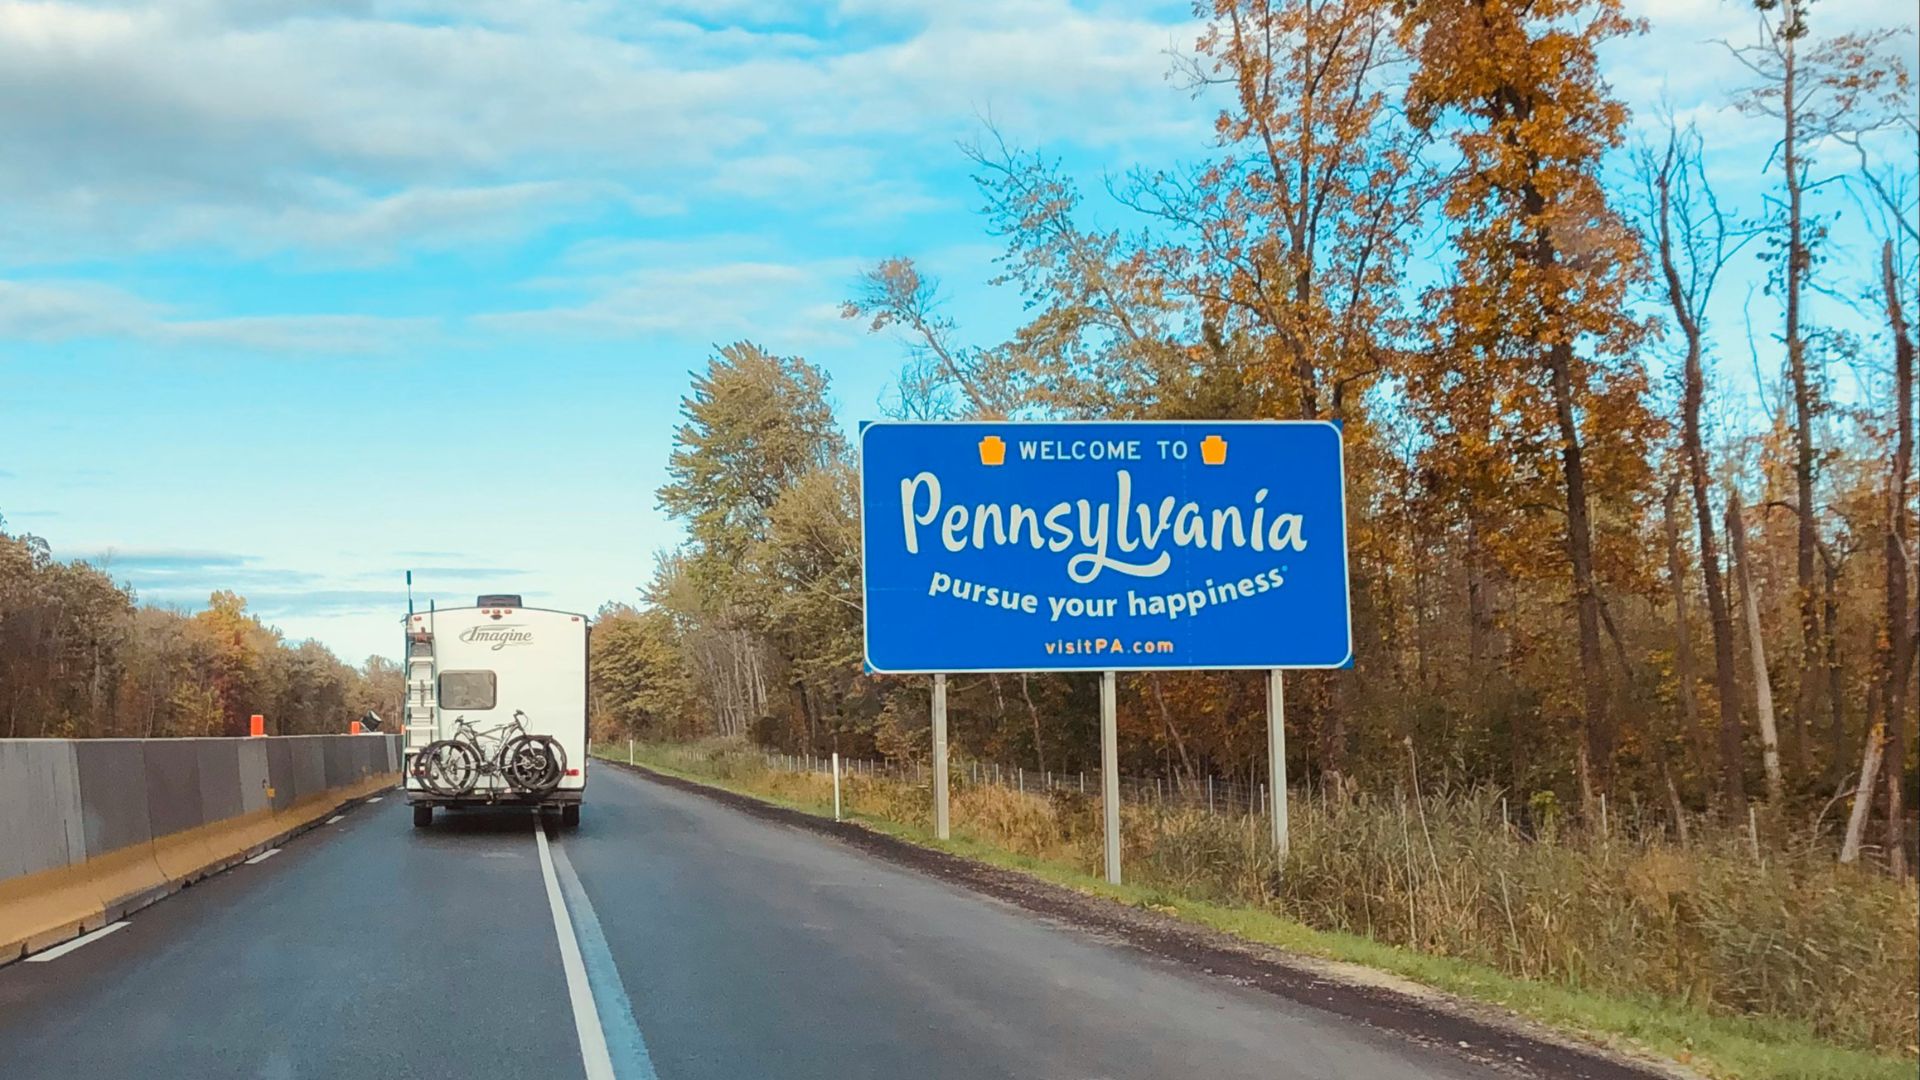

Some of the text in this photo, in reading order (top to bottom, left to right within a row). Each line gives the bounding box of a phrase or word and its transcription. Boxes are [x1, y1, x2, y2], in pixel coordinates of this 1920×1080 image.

[1019, 441, 1189, 461] WELCOME TO
[900, 470, 1309, 585] Pennsylvania
[928, 568, 1285, 623] pursue your happiness
[466, 625, 534, 651] Imagine
[1044, 637, 1175, 656] visitPA.com
